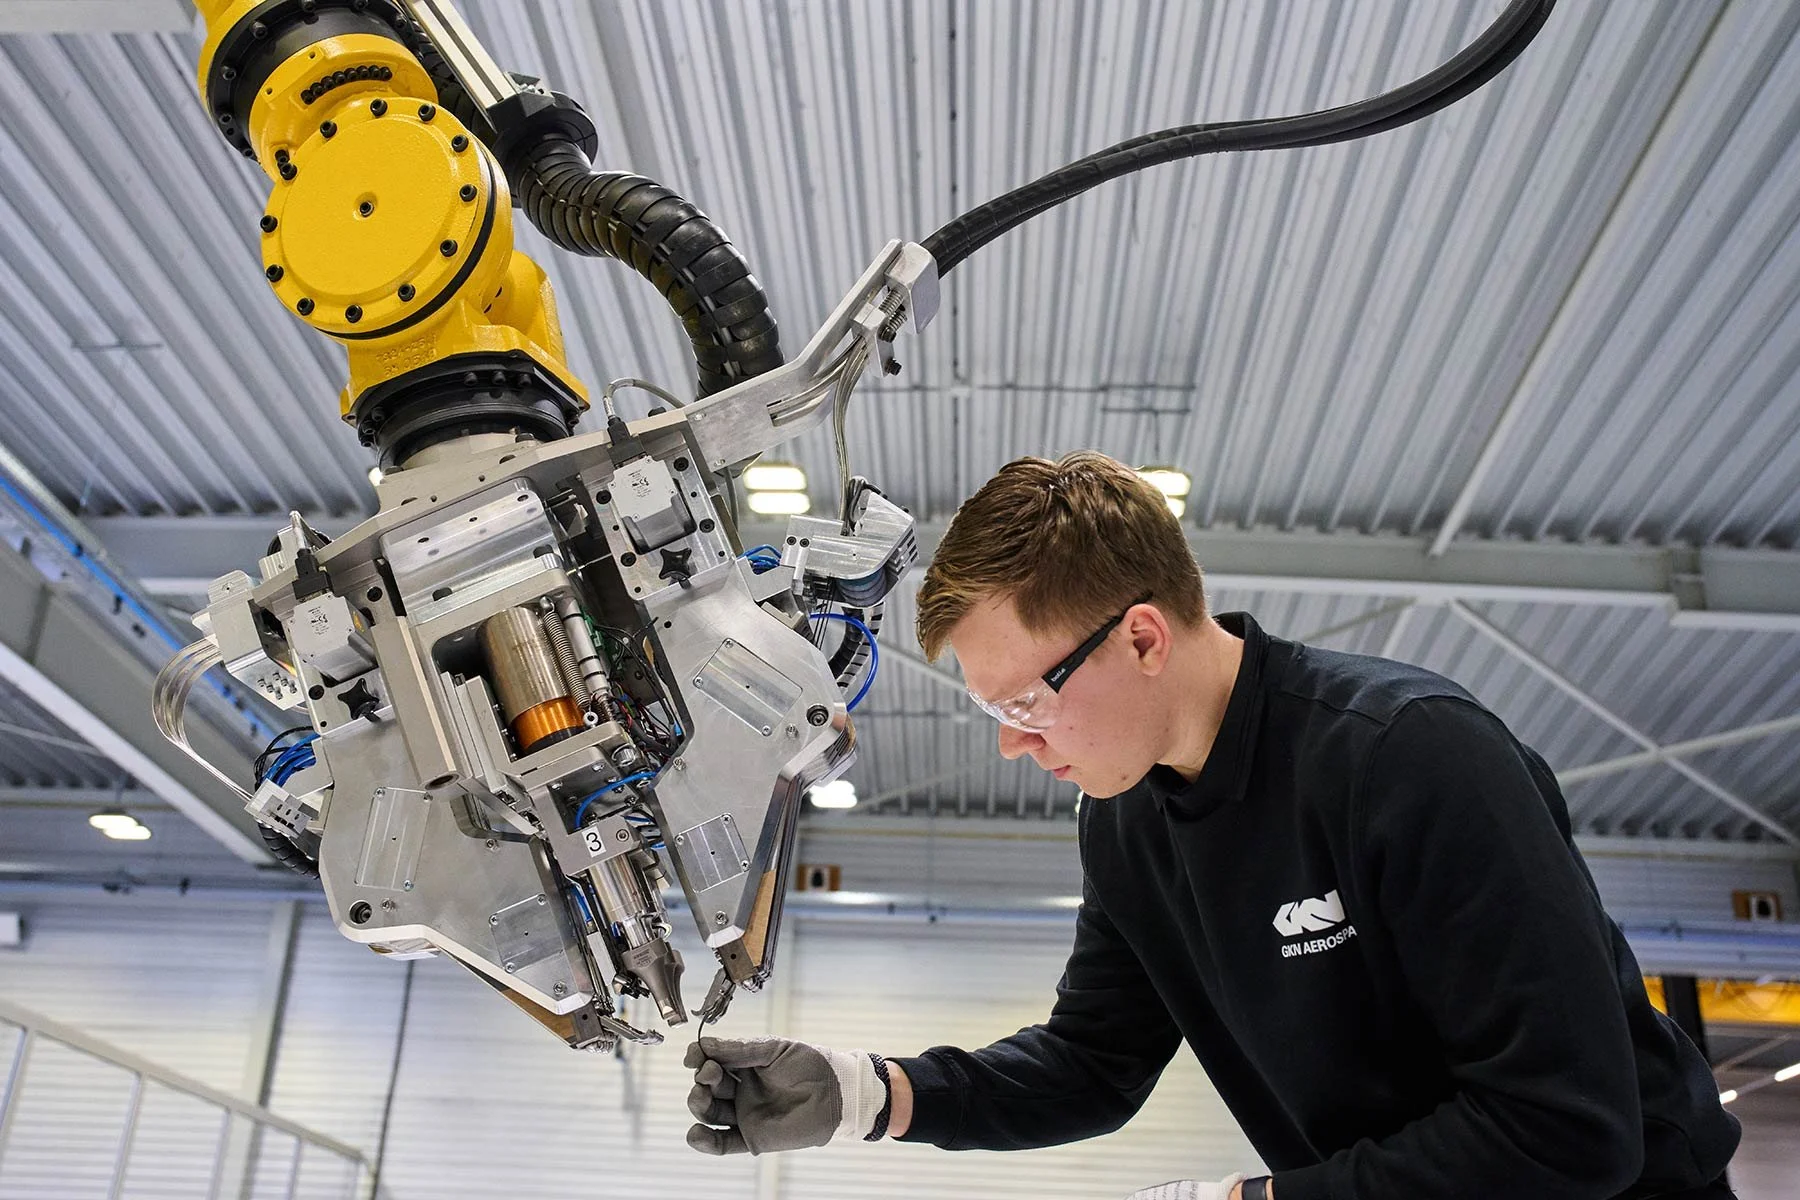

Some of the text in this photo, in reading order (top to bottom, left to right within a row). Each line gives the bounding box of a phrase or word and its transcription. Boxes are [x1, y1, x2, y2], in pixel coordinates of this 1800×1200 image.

[586, 832, 602, 852] 3
[1281, 925, 1358, 958] GKN AEROSPA
